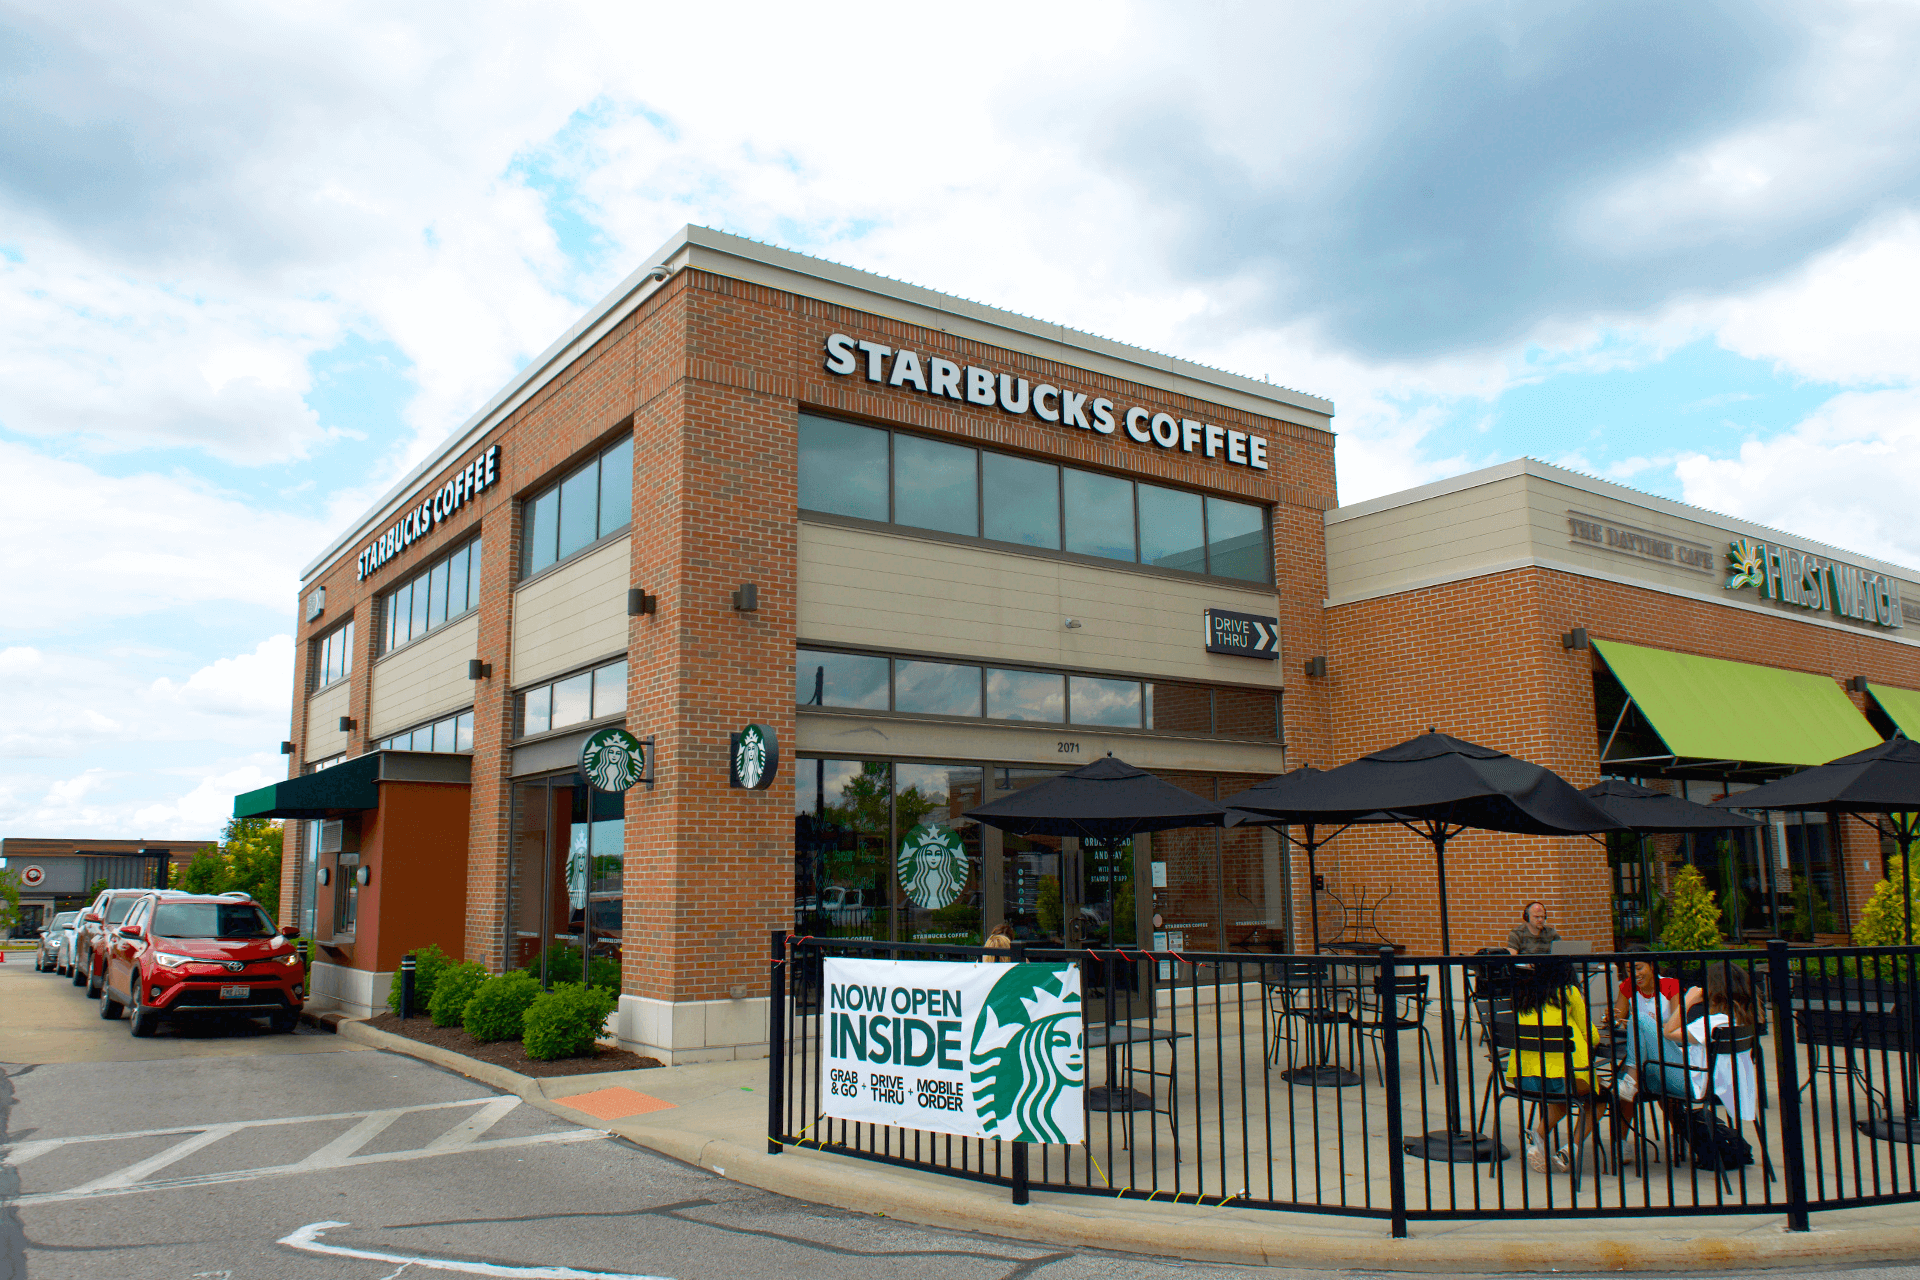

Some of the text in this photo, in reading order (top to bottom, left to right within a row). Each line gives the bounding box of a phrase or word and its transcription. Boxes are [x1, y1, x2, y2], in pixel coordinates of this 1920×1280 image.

[824, 333, 1269, 471] STARBUCKS COFFEE
[357, 445, 501, 581] STARBUCKS COFFEE
[1568, 518, 1603, 542] THE
[1607, 527, 1675, 560] DAYTIME
[1760, 544, 1904, 628] FIRST WATCH
[1215, 617, 1249, 634] DRIVE
[1216, 632, 1248, 648] THRU
[1057, 742, 1080, 753] 2071
[1094, 850, 1108, 860] AND
[830, 983, 962, 1018] NOW OPEN
[830, 1012, 964, 1071] INSIDE
[830, 1068, 858, 1084] GRAB
[870, 1073, 904, 1090] DRIVE
[831, 1082, 858, 1098] & GO
[871, 1087, 905, 1105] THRU
[916, 1078, 964, 1096] MOBILE
[917, 1093, 964, 1112] ORDER
